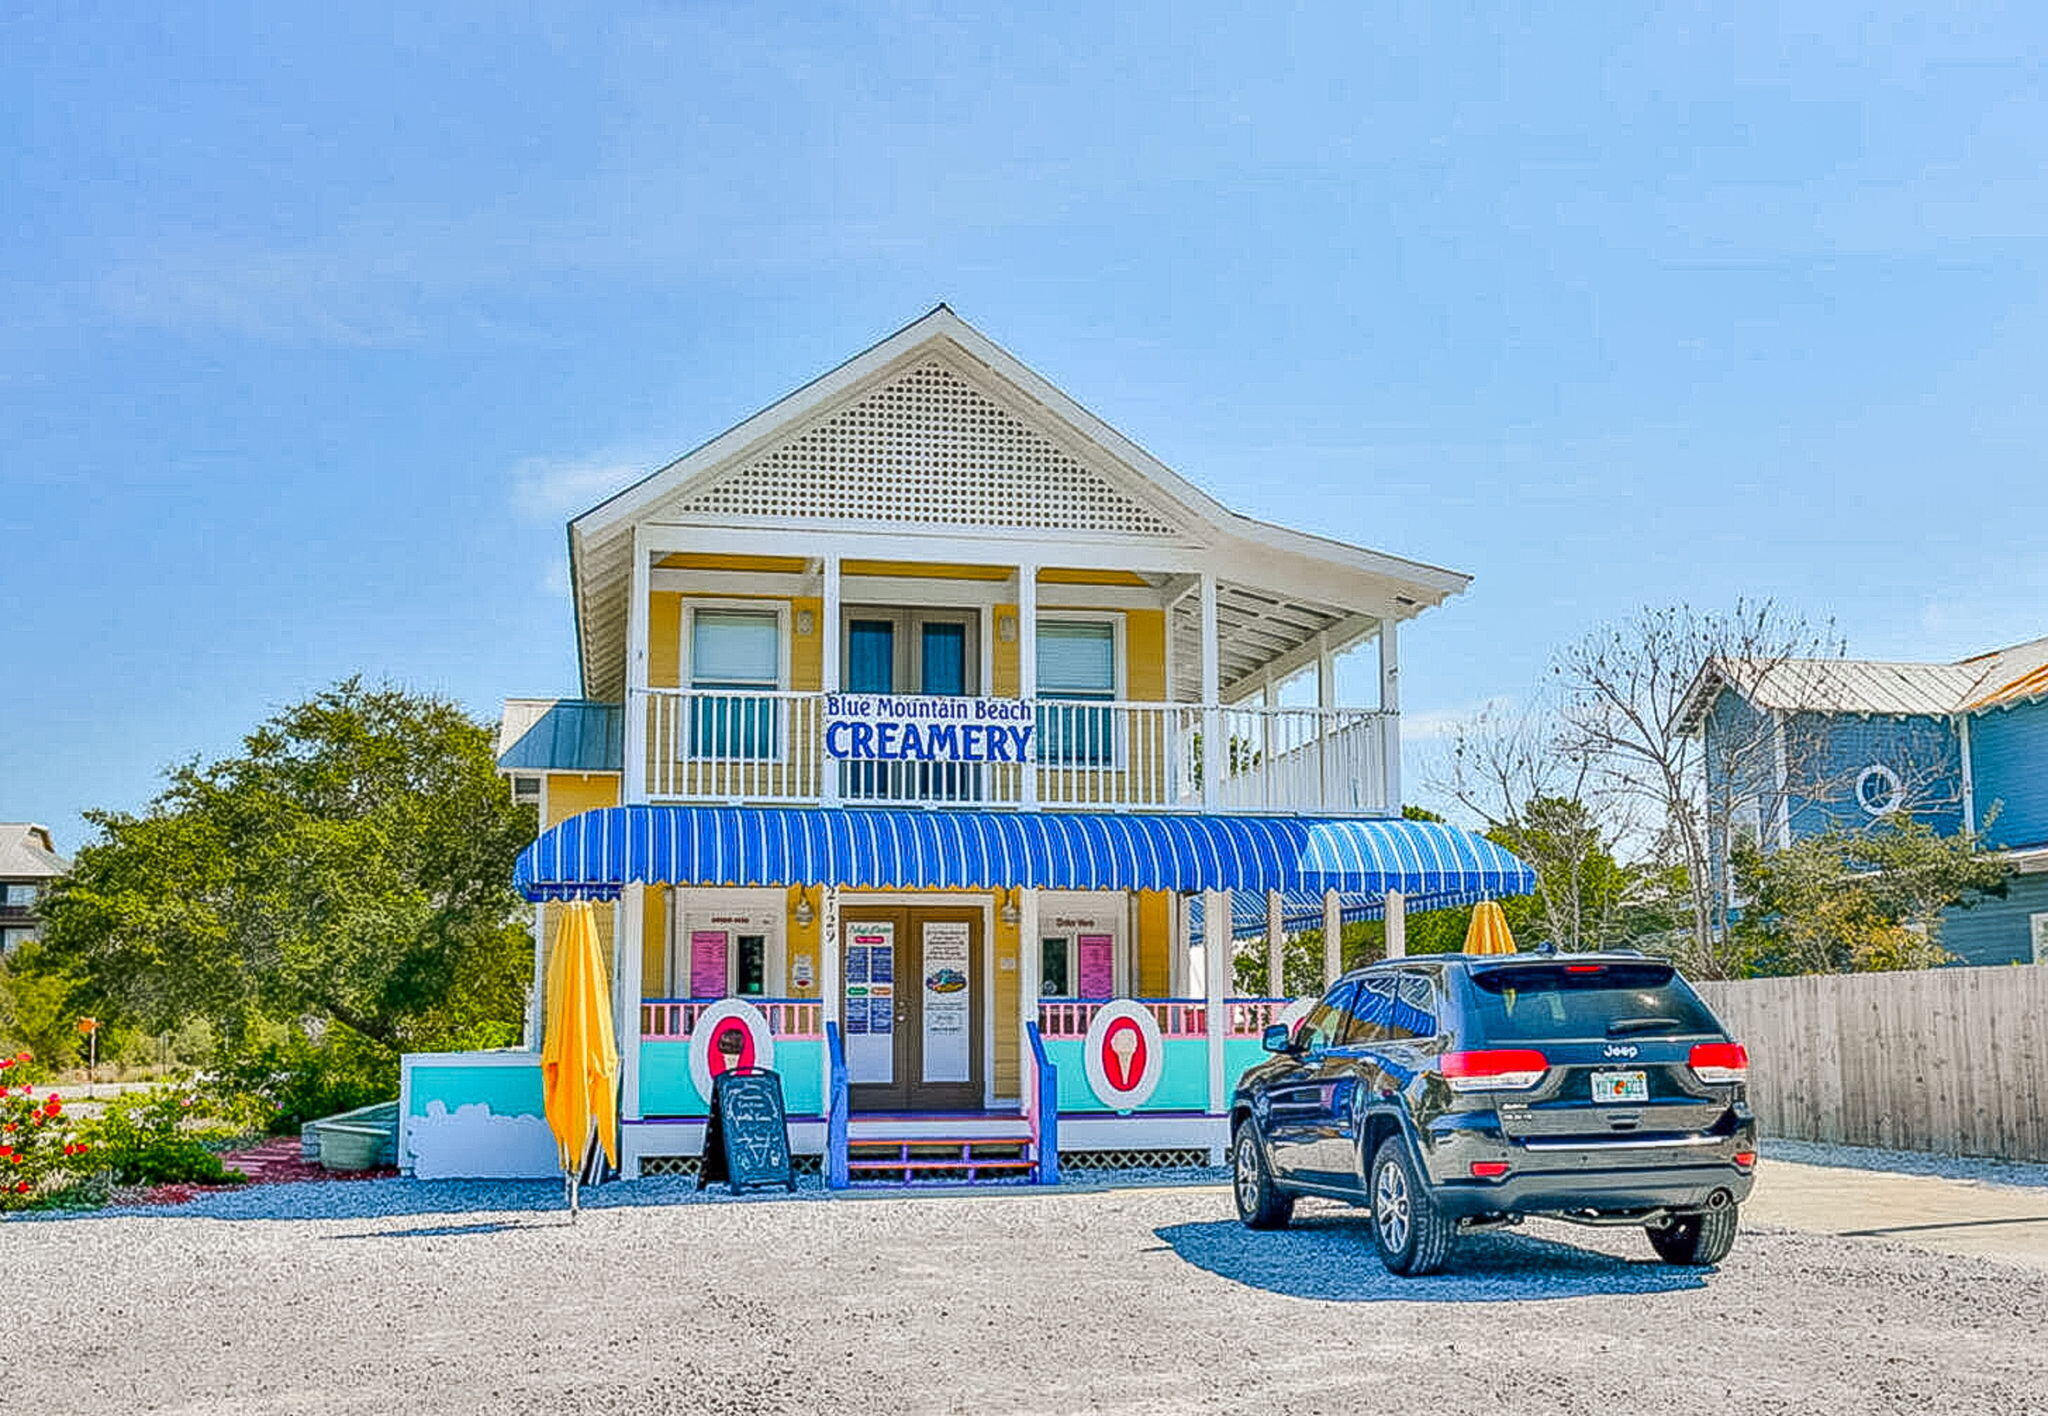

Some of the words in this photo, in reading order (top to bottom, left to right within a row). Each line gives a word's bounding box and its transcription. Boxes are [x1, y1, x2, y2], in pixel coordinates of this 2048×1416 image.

[828, 697, 871, 716] Blue
[877, 699, 968, 719] Mountain
[974, 701, 1032, 720] Beach
[825, 720, 1034, 763] CREAMERY
[1603, 1045, 1639, 1058] Jeep
